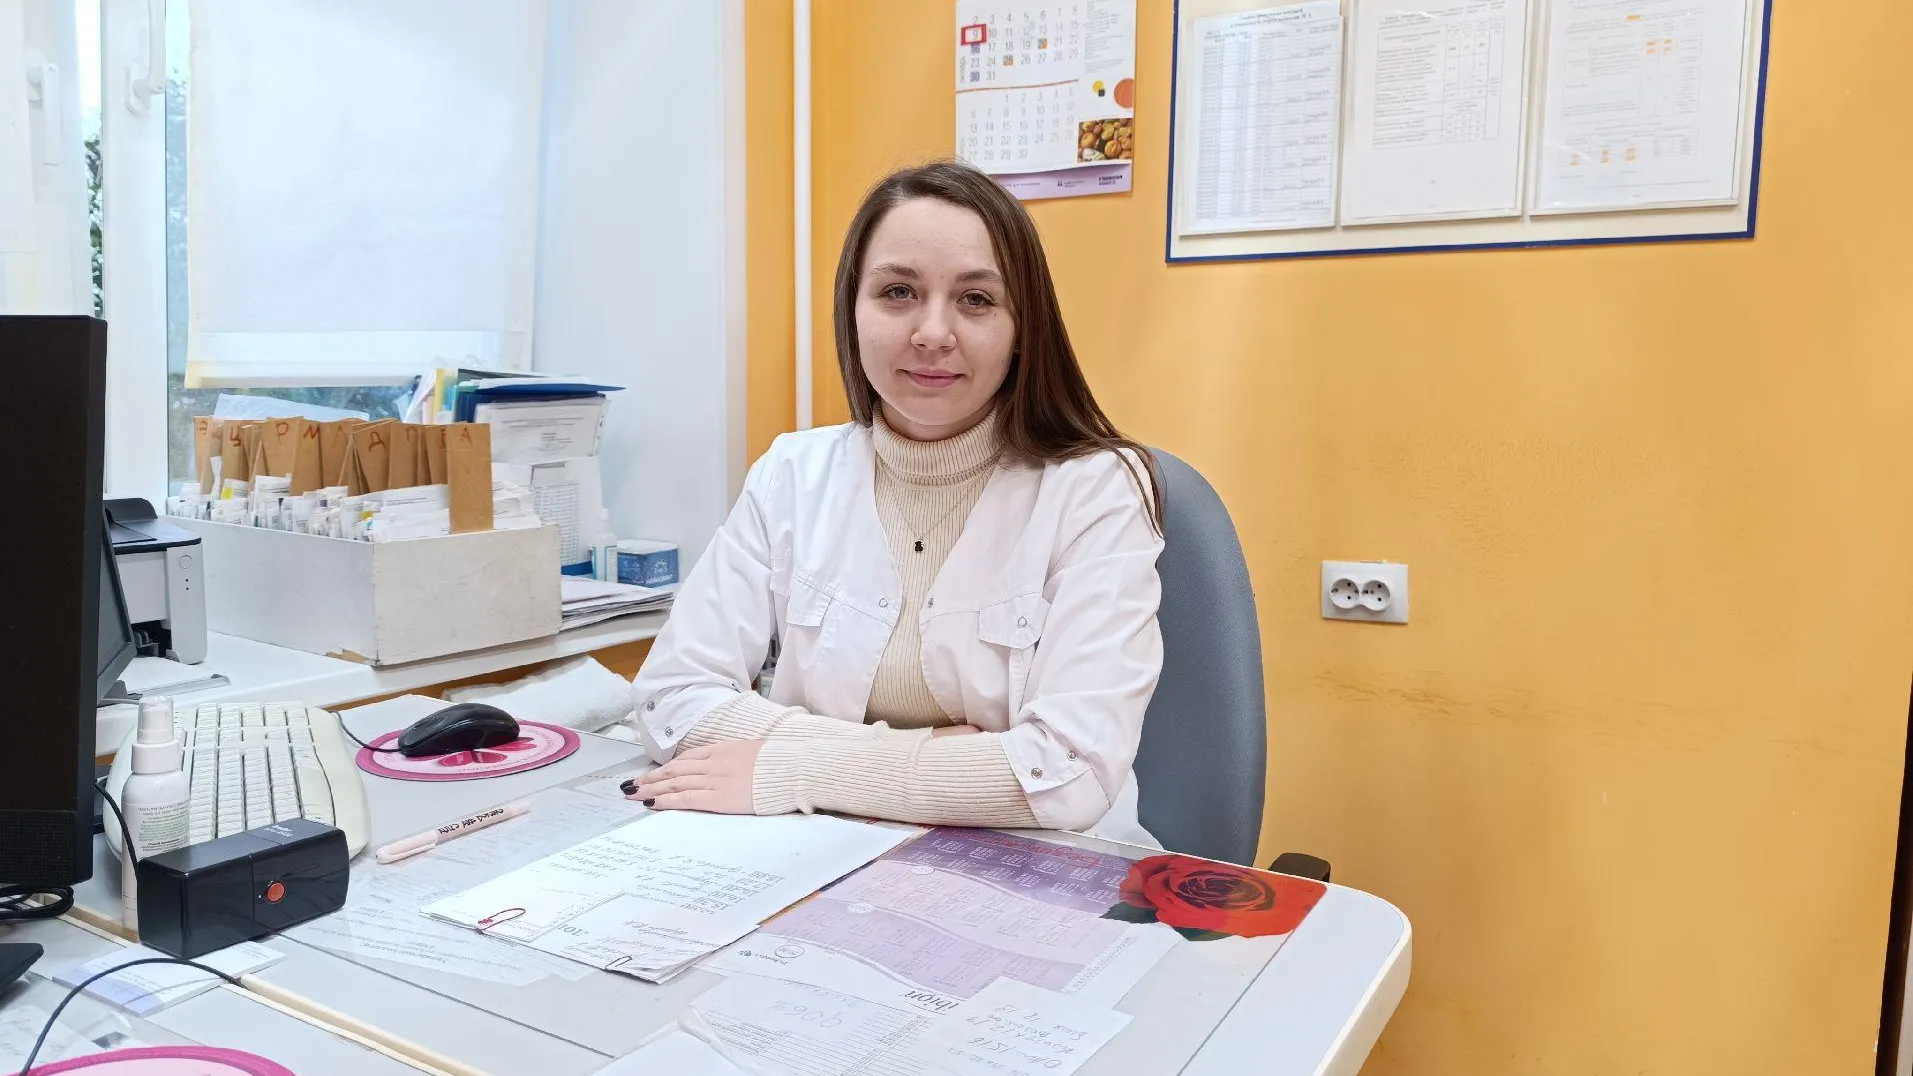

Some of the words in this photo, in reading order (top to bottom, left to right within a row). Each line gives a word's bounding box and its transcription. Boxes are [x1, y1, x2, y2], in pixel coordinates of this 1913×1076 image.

[1024, 12, 1029, 21] 5
[1041, 10, 1046, 20] 6
[989, 28, 997, 38] 10
[1006, 28, 1012, 36] 11
[989, 42, 996, 52] 17
[1006, 41, 1013, 51] 18
[276, 422, 289, 445] Р
[303, 424, 320, 440] М
[459, 427, 474, 448] А
